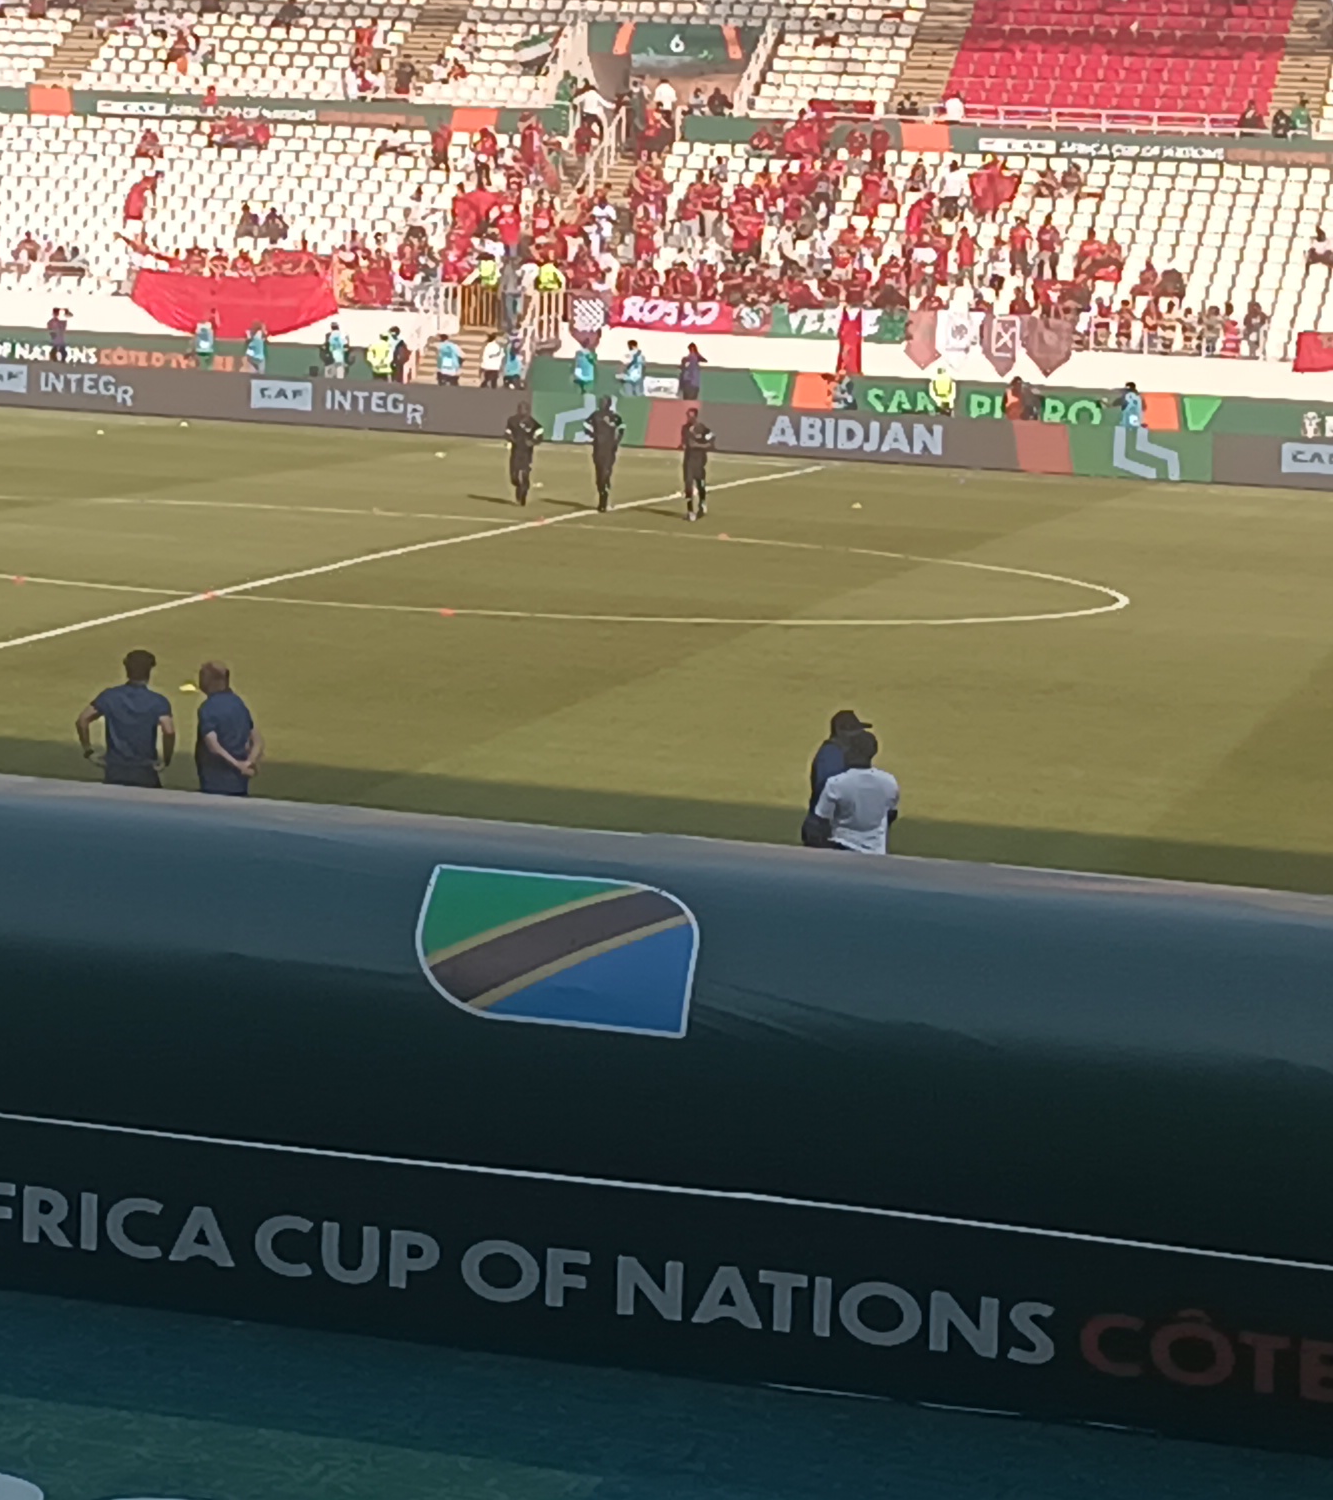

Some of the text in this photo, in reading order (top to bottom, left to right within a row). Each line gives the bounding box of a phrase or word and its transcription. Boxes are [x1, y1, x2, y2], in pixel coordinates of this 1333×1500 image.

[669, 34, 685, 53] 6
[787, 307, 884, 337] VERE
[15, 342, 98, 366] NATONS
[969, 392, 1103, 425] PRO
[766, 414, 944, 455] ABIDJAN
[253, 1213, 442, 1290] CUP
[460, 1239, 593, 1308] OF
[615, 1253, 1057, 1366] NATIONS
[1079, 1307, 1333, 1404] CÔTE
